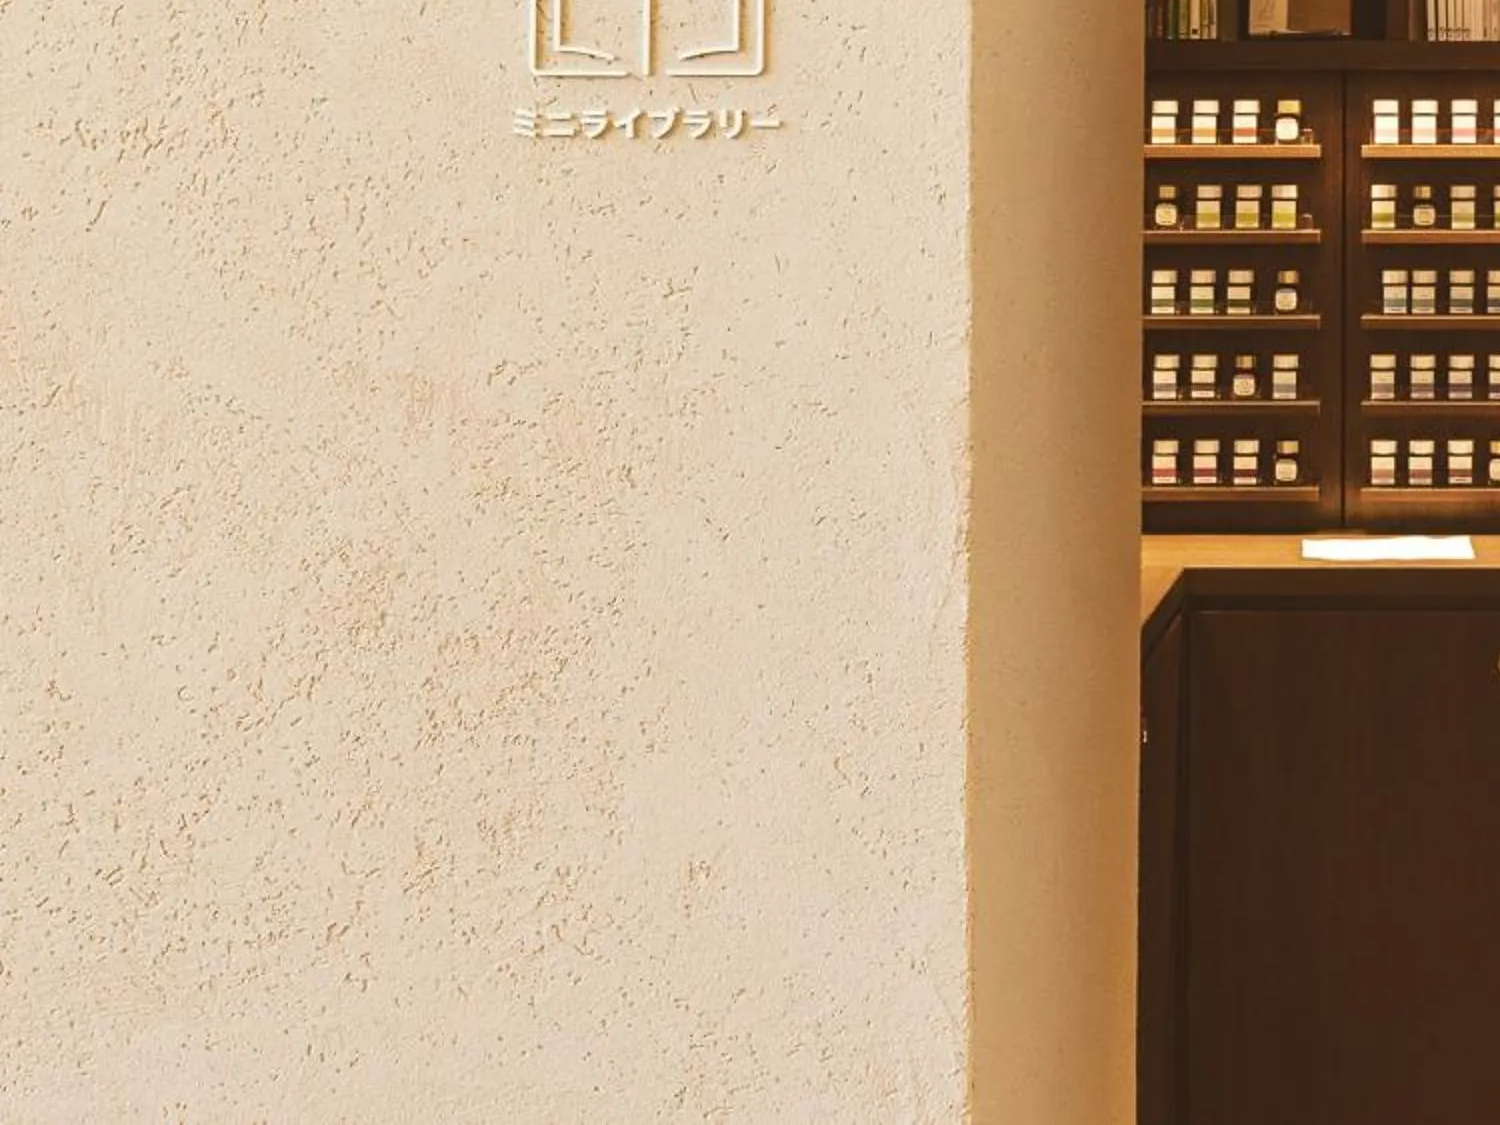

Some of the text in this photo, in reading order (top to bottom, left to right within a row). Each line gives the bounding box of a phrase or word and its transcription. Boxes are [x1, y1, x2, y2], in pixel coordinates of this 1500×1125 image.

[512, 105, 785, 139] ミニライブラリー
